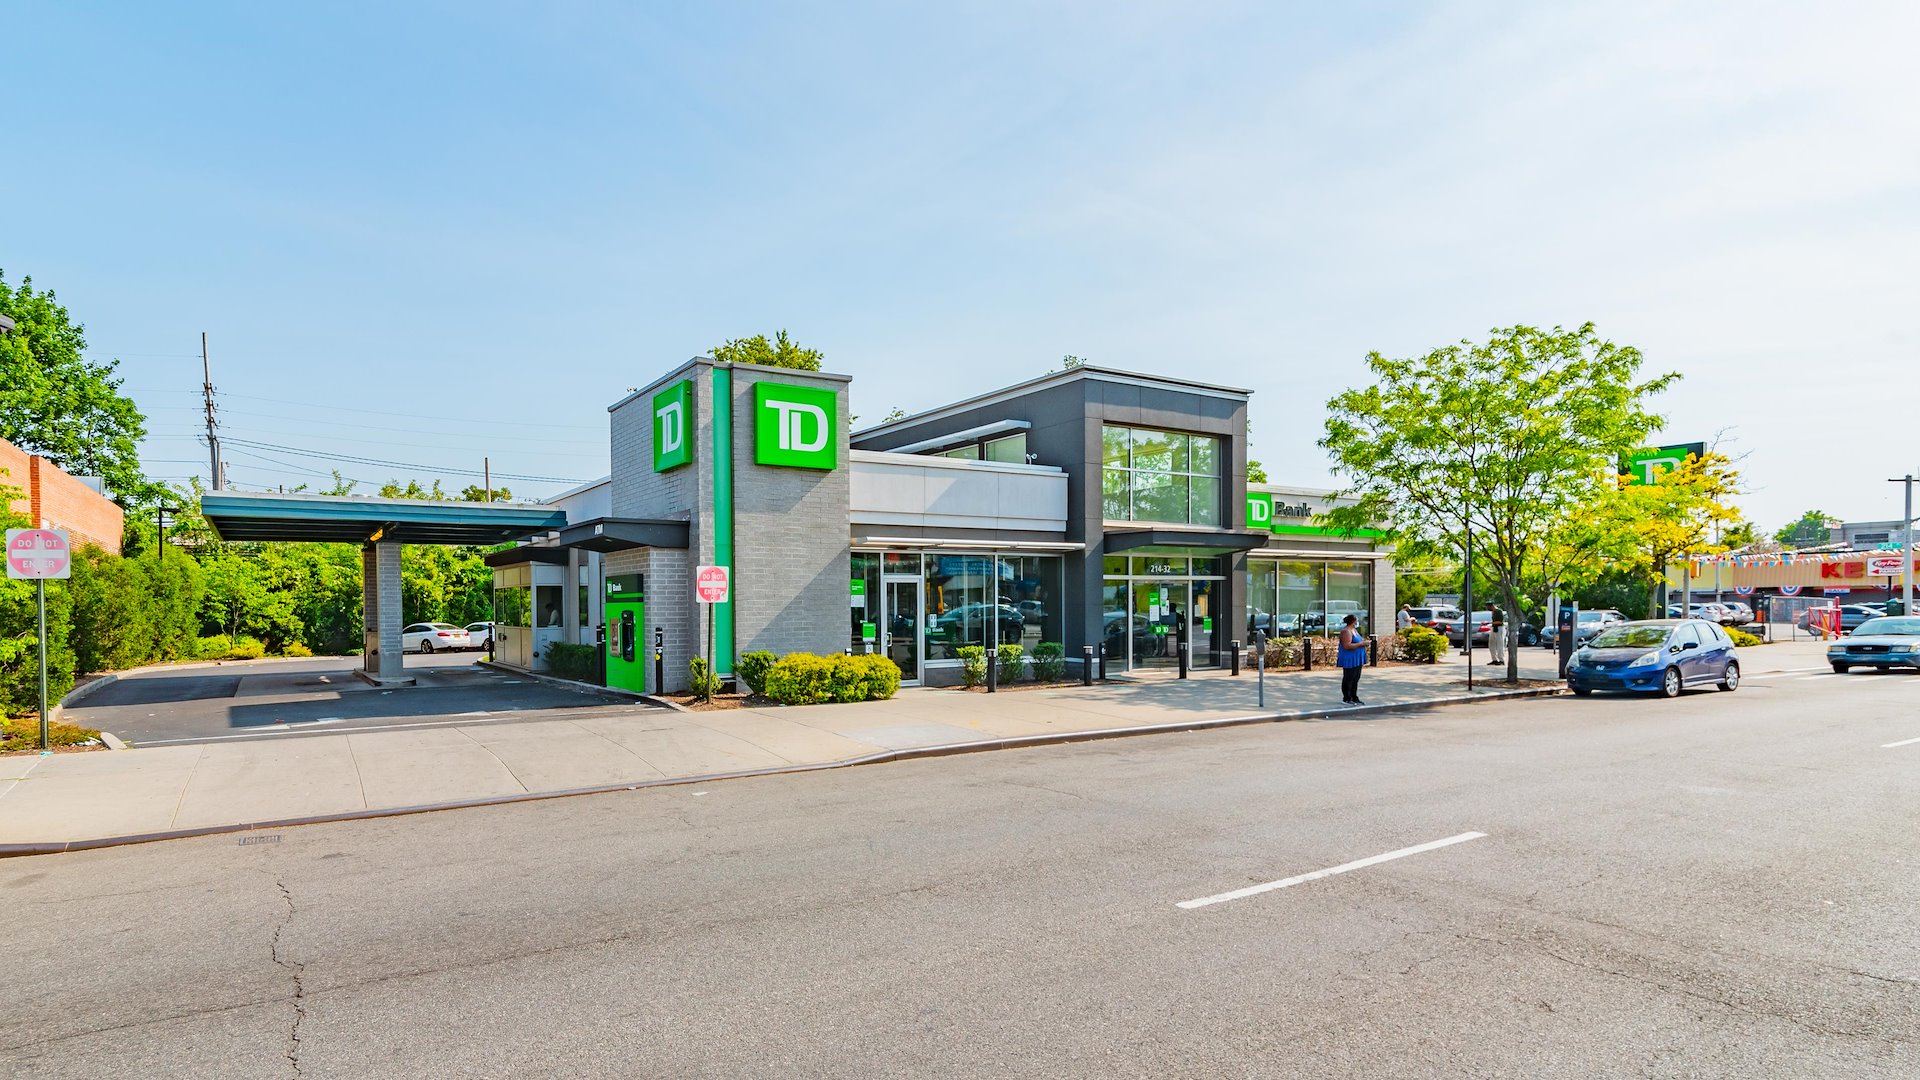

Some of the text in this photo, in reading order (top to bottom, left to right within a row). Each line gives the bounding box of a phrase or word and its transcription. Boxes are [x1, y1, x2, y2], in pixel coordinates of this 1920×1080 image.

[656, 401, 682, 455] TD
[765, 399, 829, 452] TD
[1248, 499, 1312, 522] TD Bank
[1150, 565, 1171, 573] 214-32
[613, 583, 622, 591] Bank
[1564, 611, 1571, 620] P
